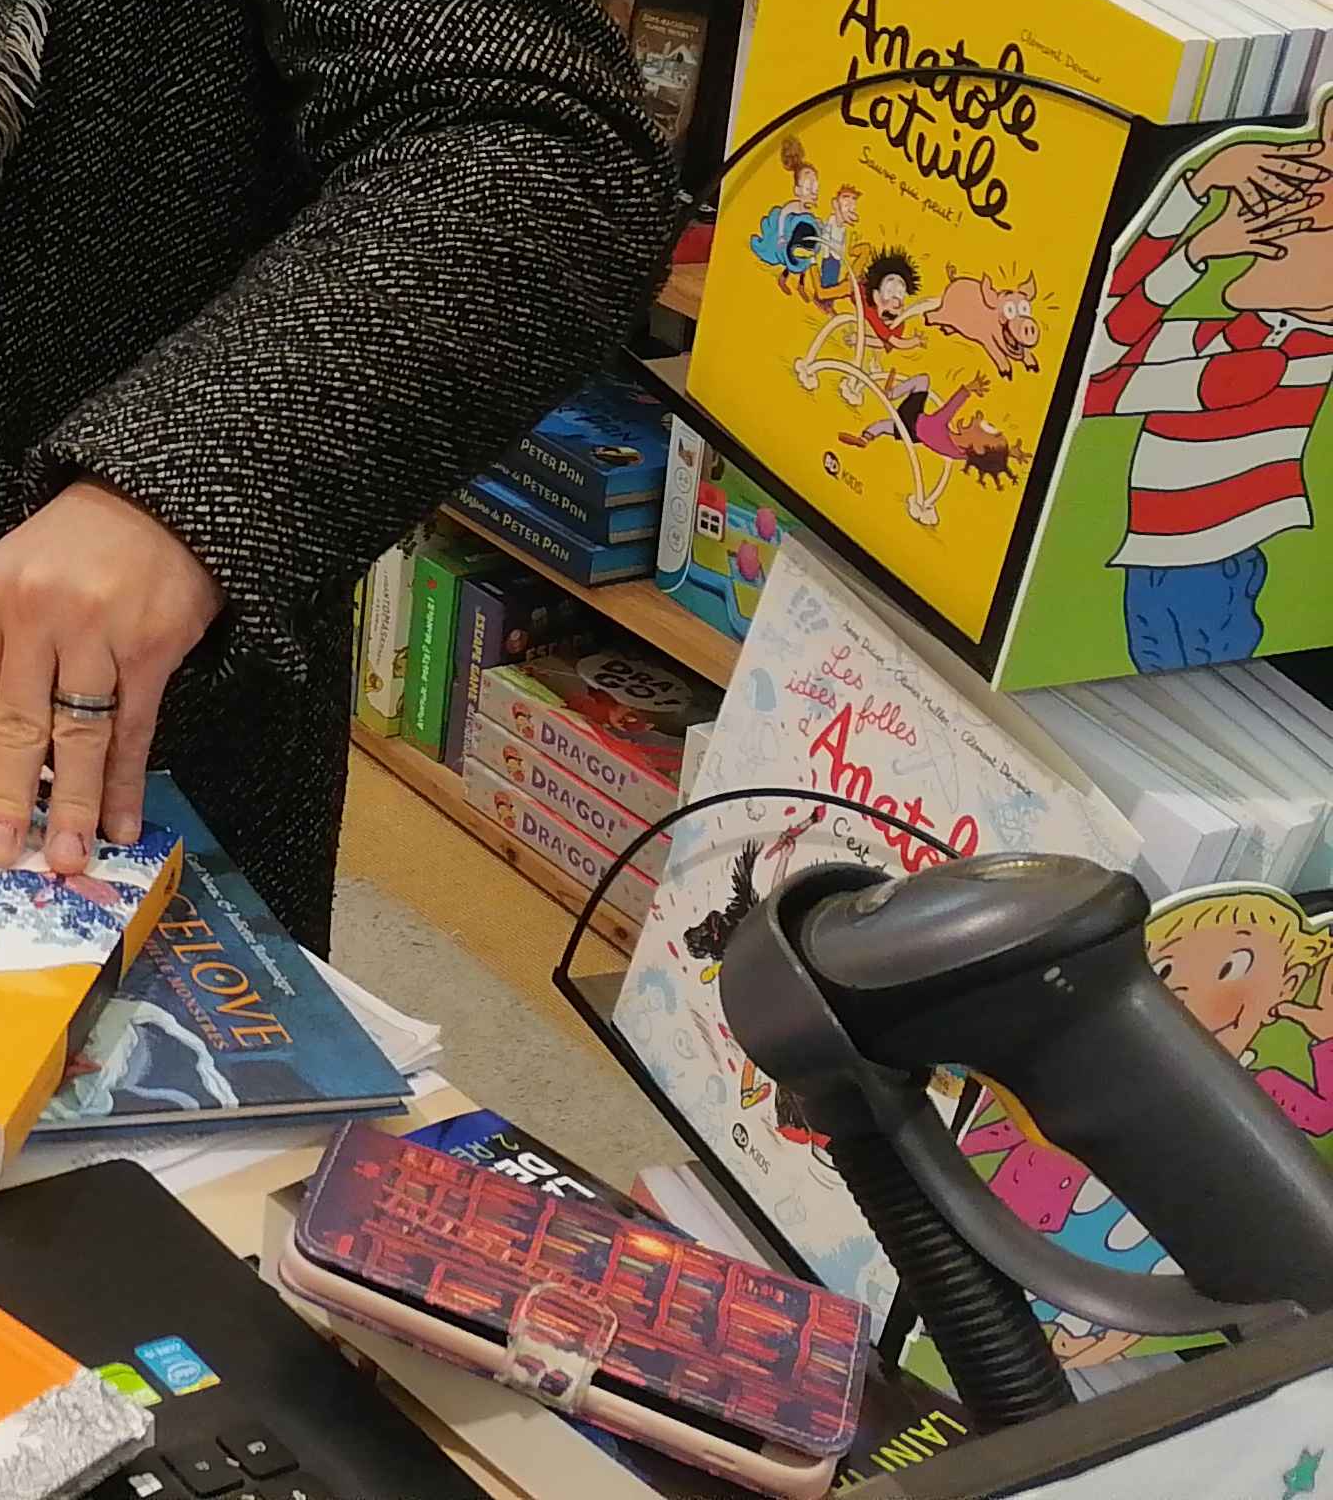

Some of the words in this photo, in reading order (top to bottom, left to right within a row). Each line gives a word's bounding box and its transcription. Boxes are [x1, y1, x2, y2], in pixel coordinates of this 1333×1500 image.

[840, 55, 1014, 232] Latuile
[858, 145, 899, 187] Sauve
[898, 178, 921, 202] qui
[921, 190, 955, 223] peut
[519, 435, 559, 477] PETER
[557, 459, 586, 488] PAN
[841, 467, 865, 495] KIDS
[522, 472, 561, 510] PETER
[560, 495, 590, 524] PAN
[502, 512, 541, 548] PETER
[541, 536, 571, 563] PAN
[821, 645, 864, 691] Les
[785, 671, 838, 710] idées
[854, 693, 917, 747] folles
[540, 722, 627, 793] DRA'GO!
[530, 766, 616, 839] DRA'GO!
[809, 702, 980, 874] Anatol
[832, 815, 873, 865] C'est
[746, 1145, 772, 1176] KIDS
[868, 1410, 967, 1474] LAINI
